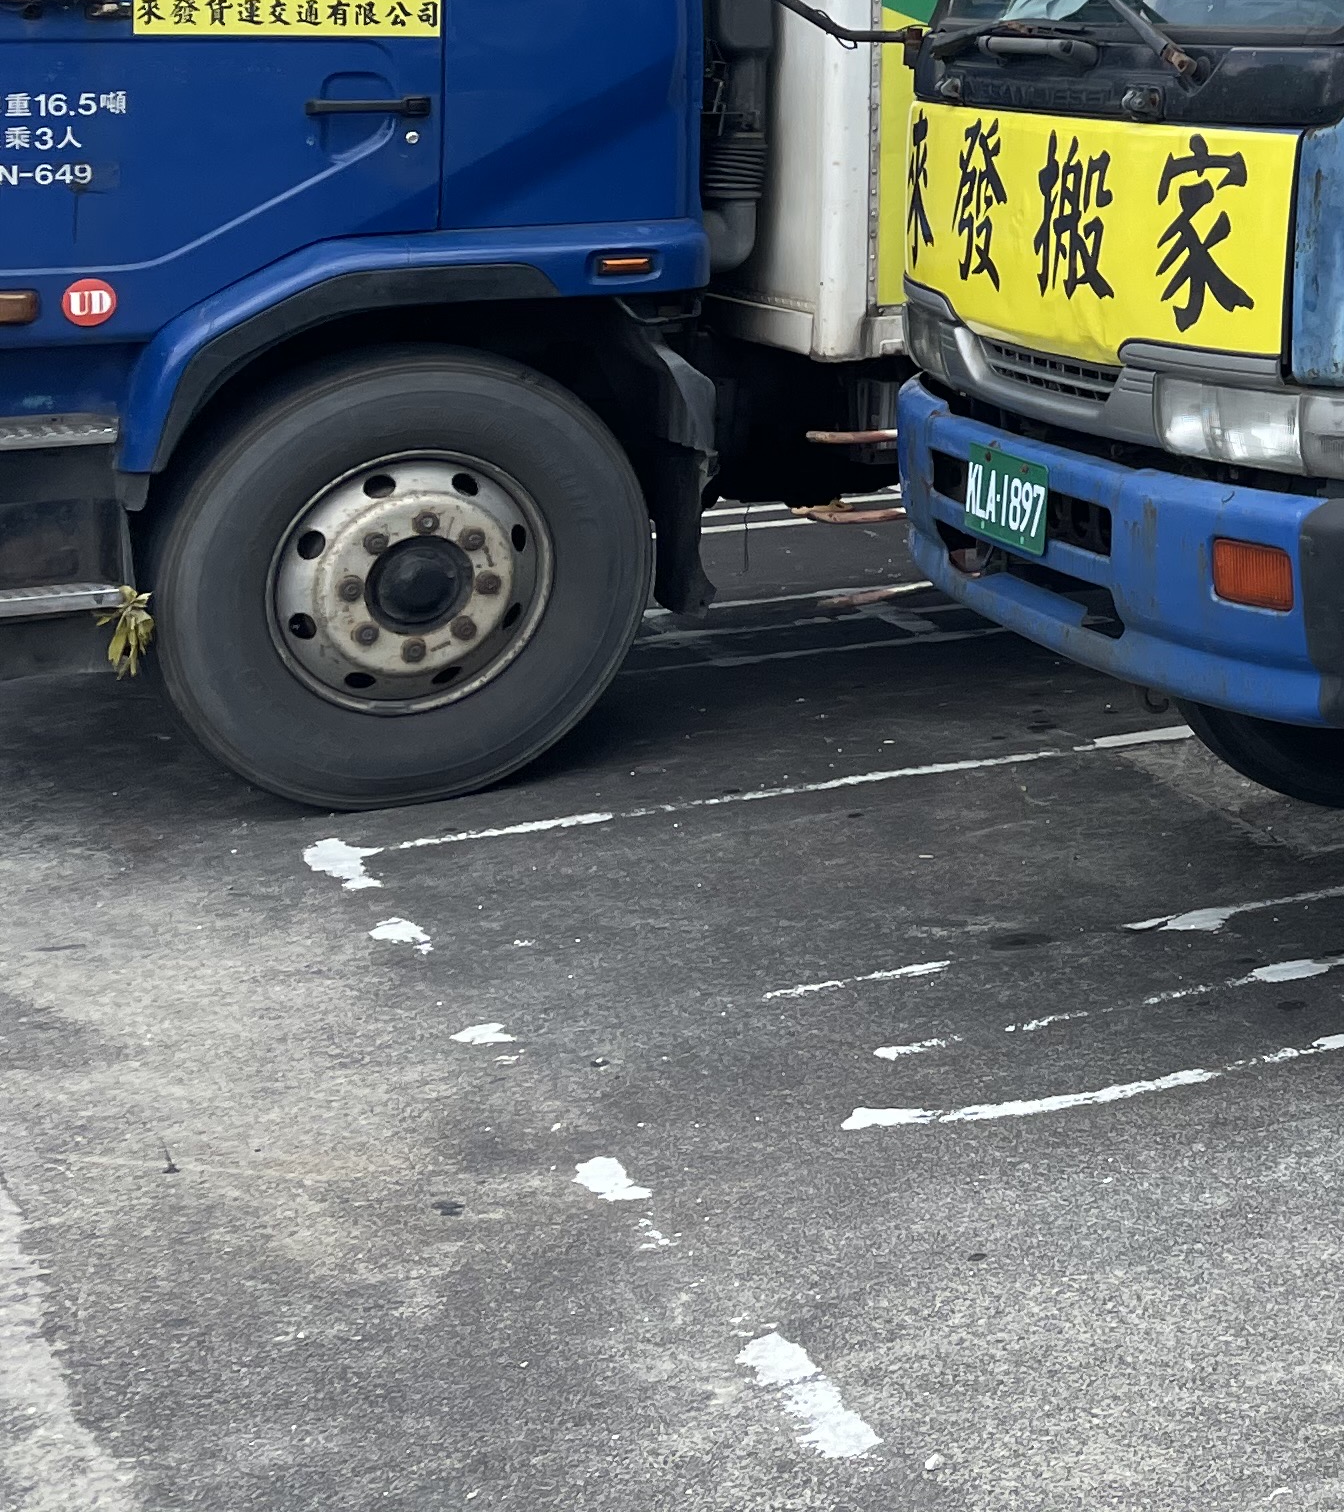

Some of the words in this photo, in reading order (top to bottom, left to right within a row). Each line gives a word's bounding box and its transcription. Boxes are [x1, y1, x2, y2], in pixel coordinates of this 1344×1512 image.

[906, 108, 1255, 333] 來發搬家
[69, 290, 112, 317] UD
[965, 461, 1046, 538] KLA-1897
